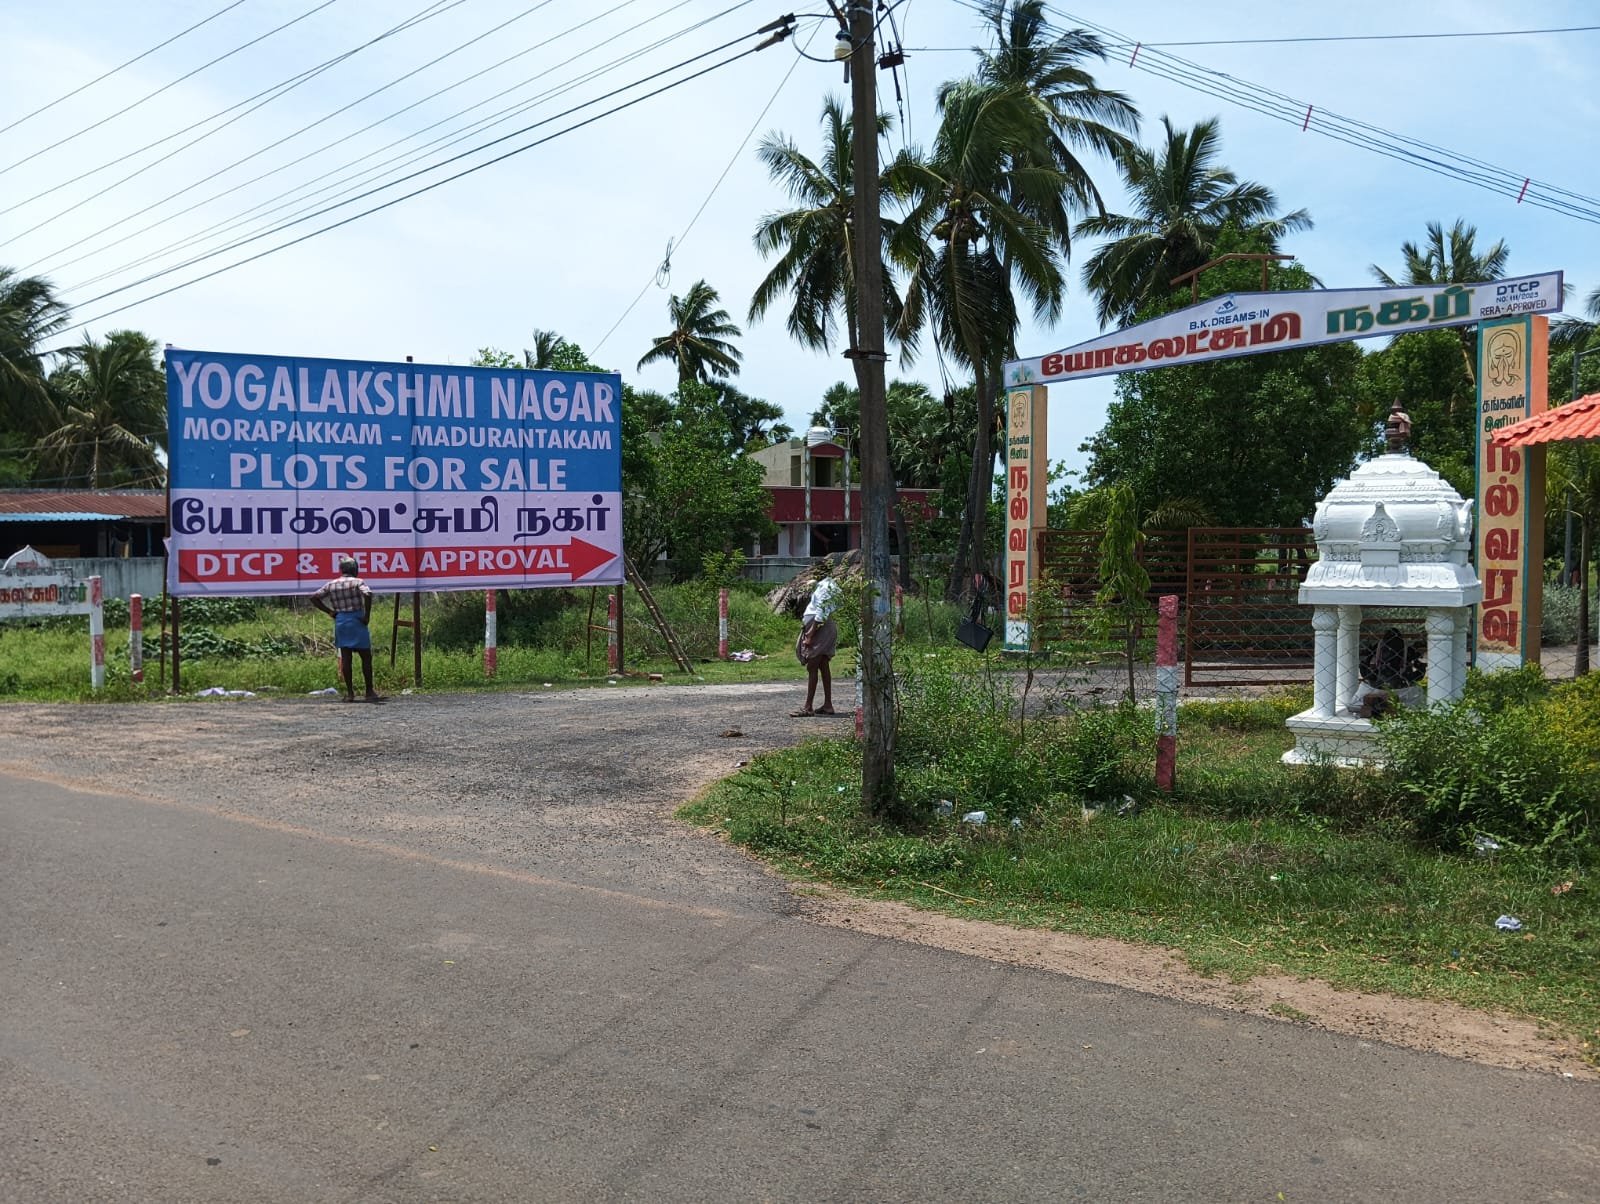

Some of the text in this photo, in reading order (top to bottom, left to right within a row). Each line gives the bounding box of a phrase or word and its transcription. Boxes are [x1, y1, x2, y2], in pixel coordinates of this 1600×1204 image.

[1496, 281, 1540, 296] DTCP
[1041, 285, 1475, 377] யோகலட்சுமி நகர்
[172, 361, 615, 423] YOGALAKSHMI NAGAR
[183, 417, 382, 445] MORAPAKKAM
[411, 425, 612, 450] MADURANTAKAM
[230, 453, 567, 491] PLOTS FOR SALE
[172, 494, 610, 542] யோகலட்சுமி நகர்
[196, 552, 284, 576] DTCP
[296, 552, 320, 574] &
[419, 549, 569, 572] APPROVAL
